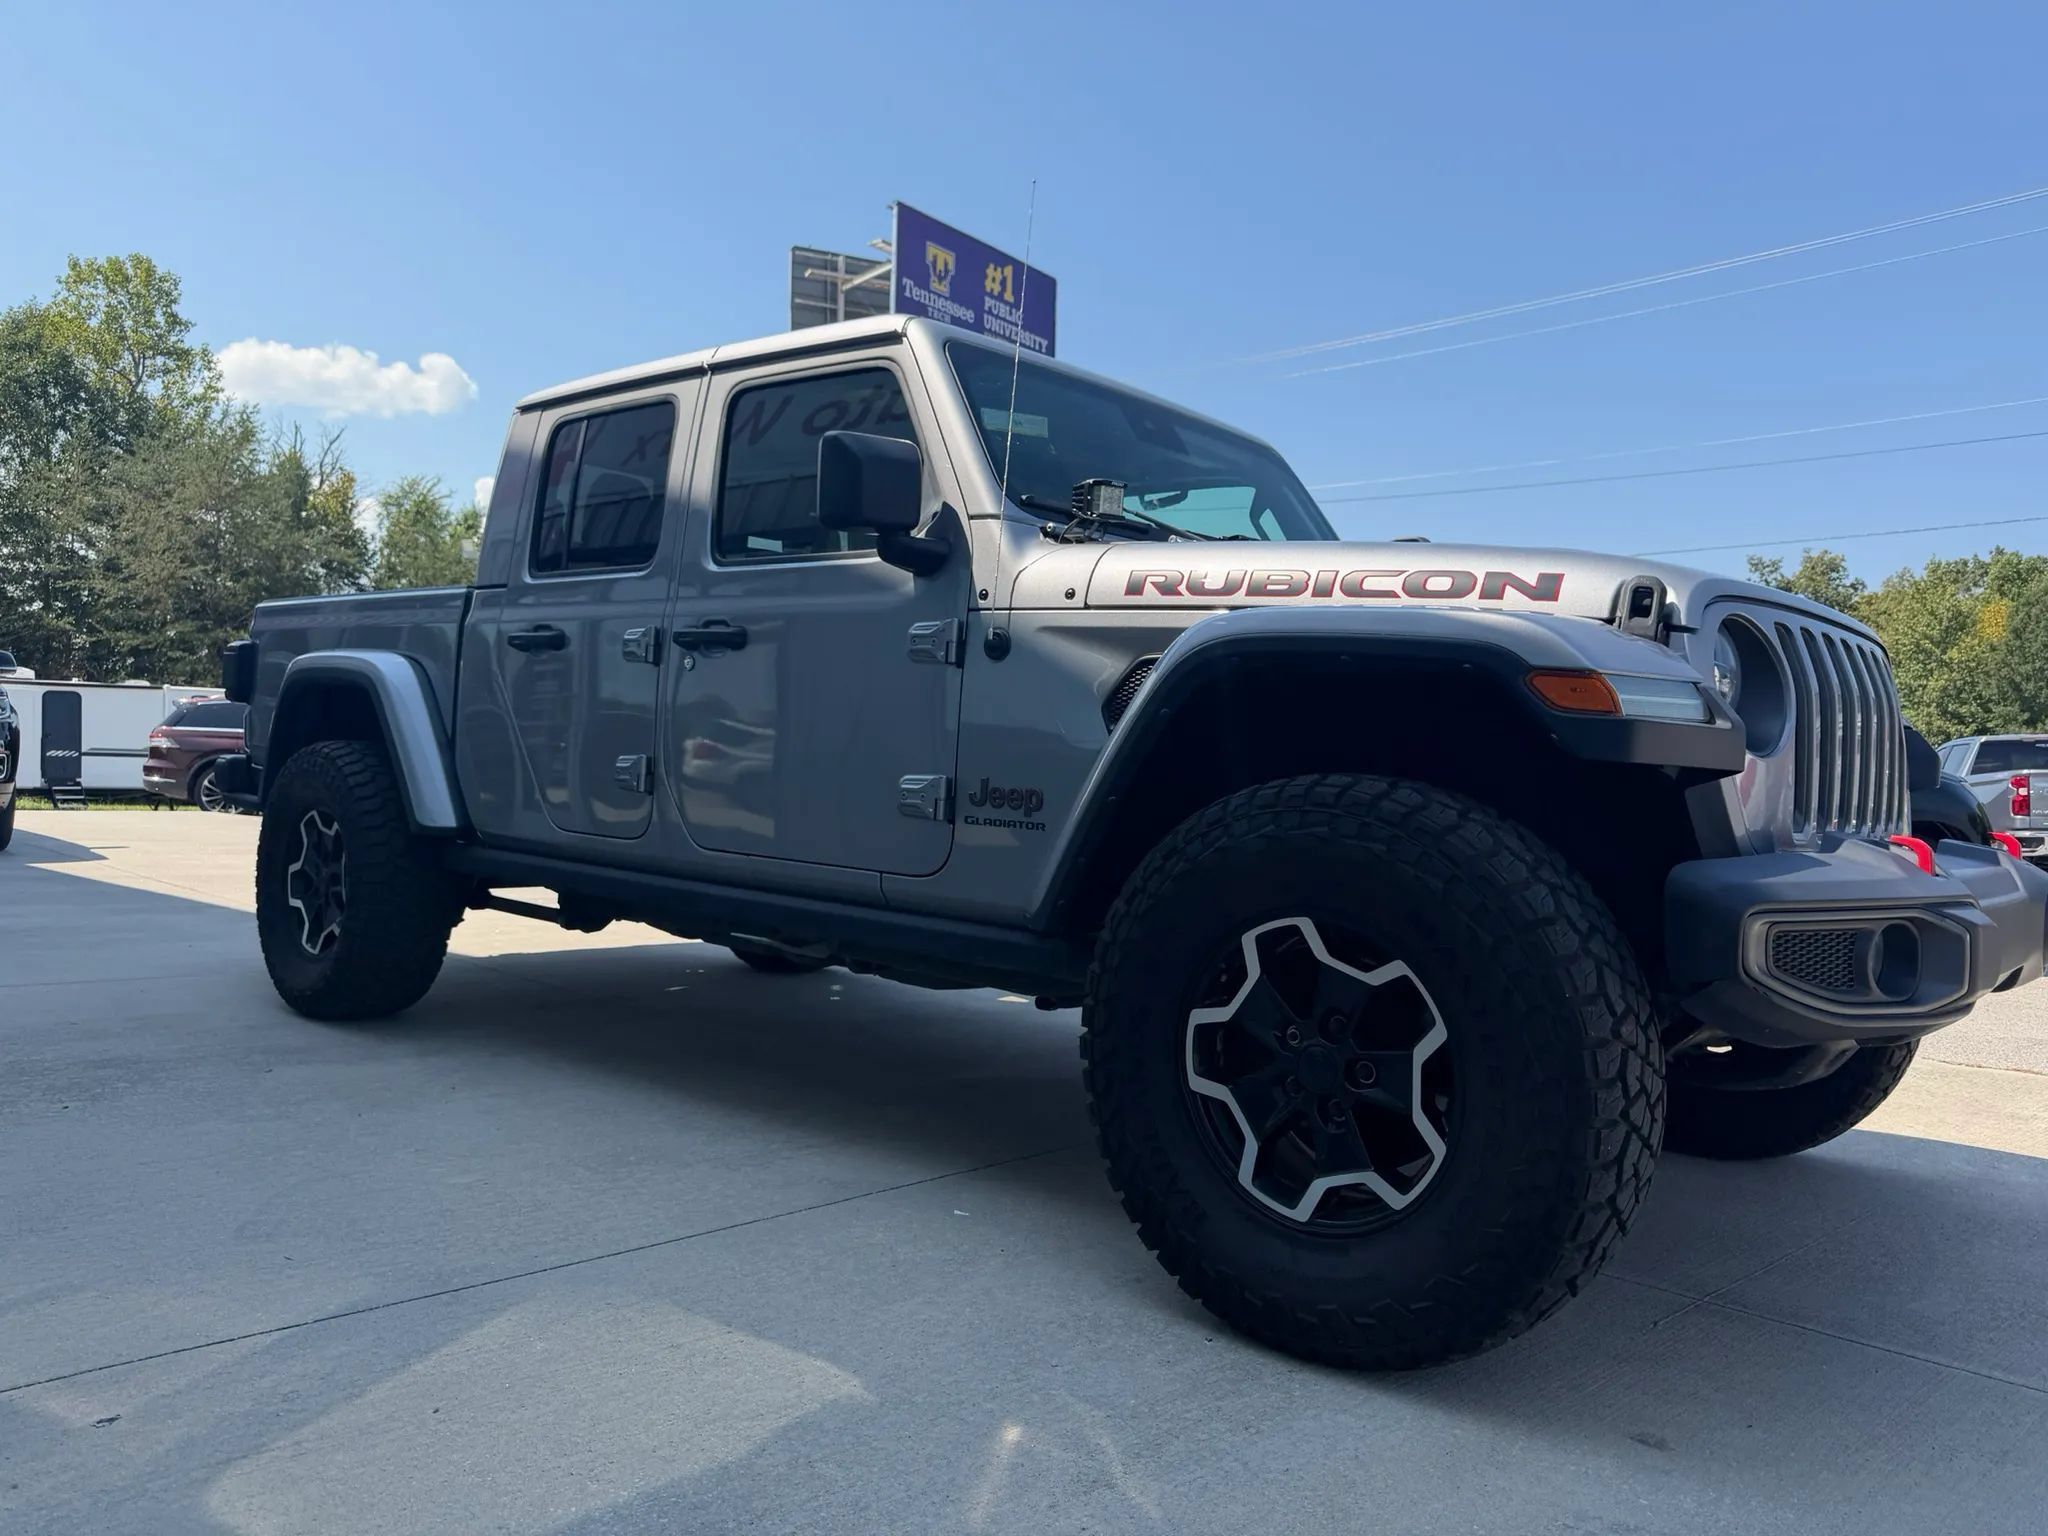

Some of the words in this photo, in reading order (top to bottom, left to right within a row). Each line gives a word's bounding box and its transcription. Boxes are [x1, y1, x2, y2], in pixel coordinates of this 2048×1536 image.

[902, 277, 975, 323] Tennessee
[984, 262, 1014, 303] #1
[984, 296, 1024, 325] PUBLIC
[983, 314, 1049, 353] UNIVERSITY
[1124, 569, 1565, 602] RUBICON
[968, 777, 1044, 817] Jeep
[964, 815, 1046, 832] GLADIATOR
